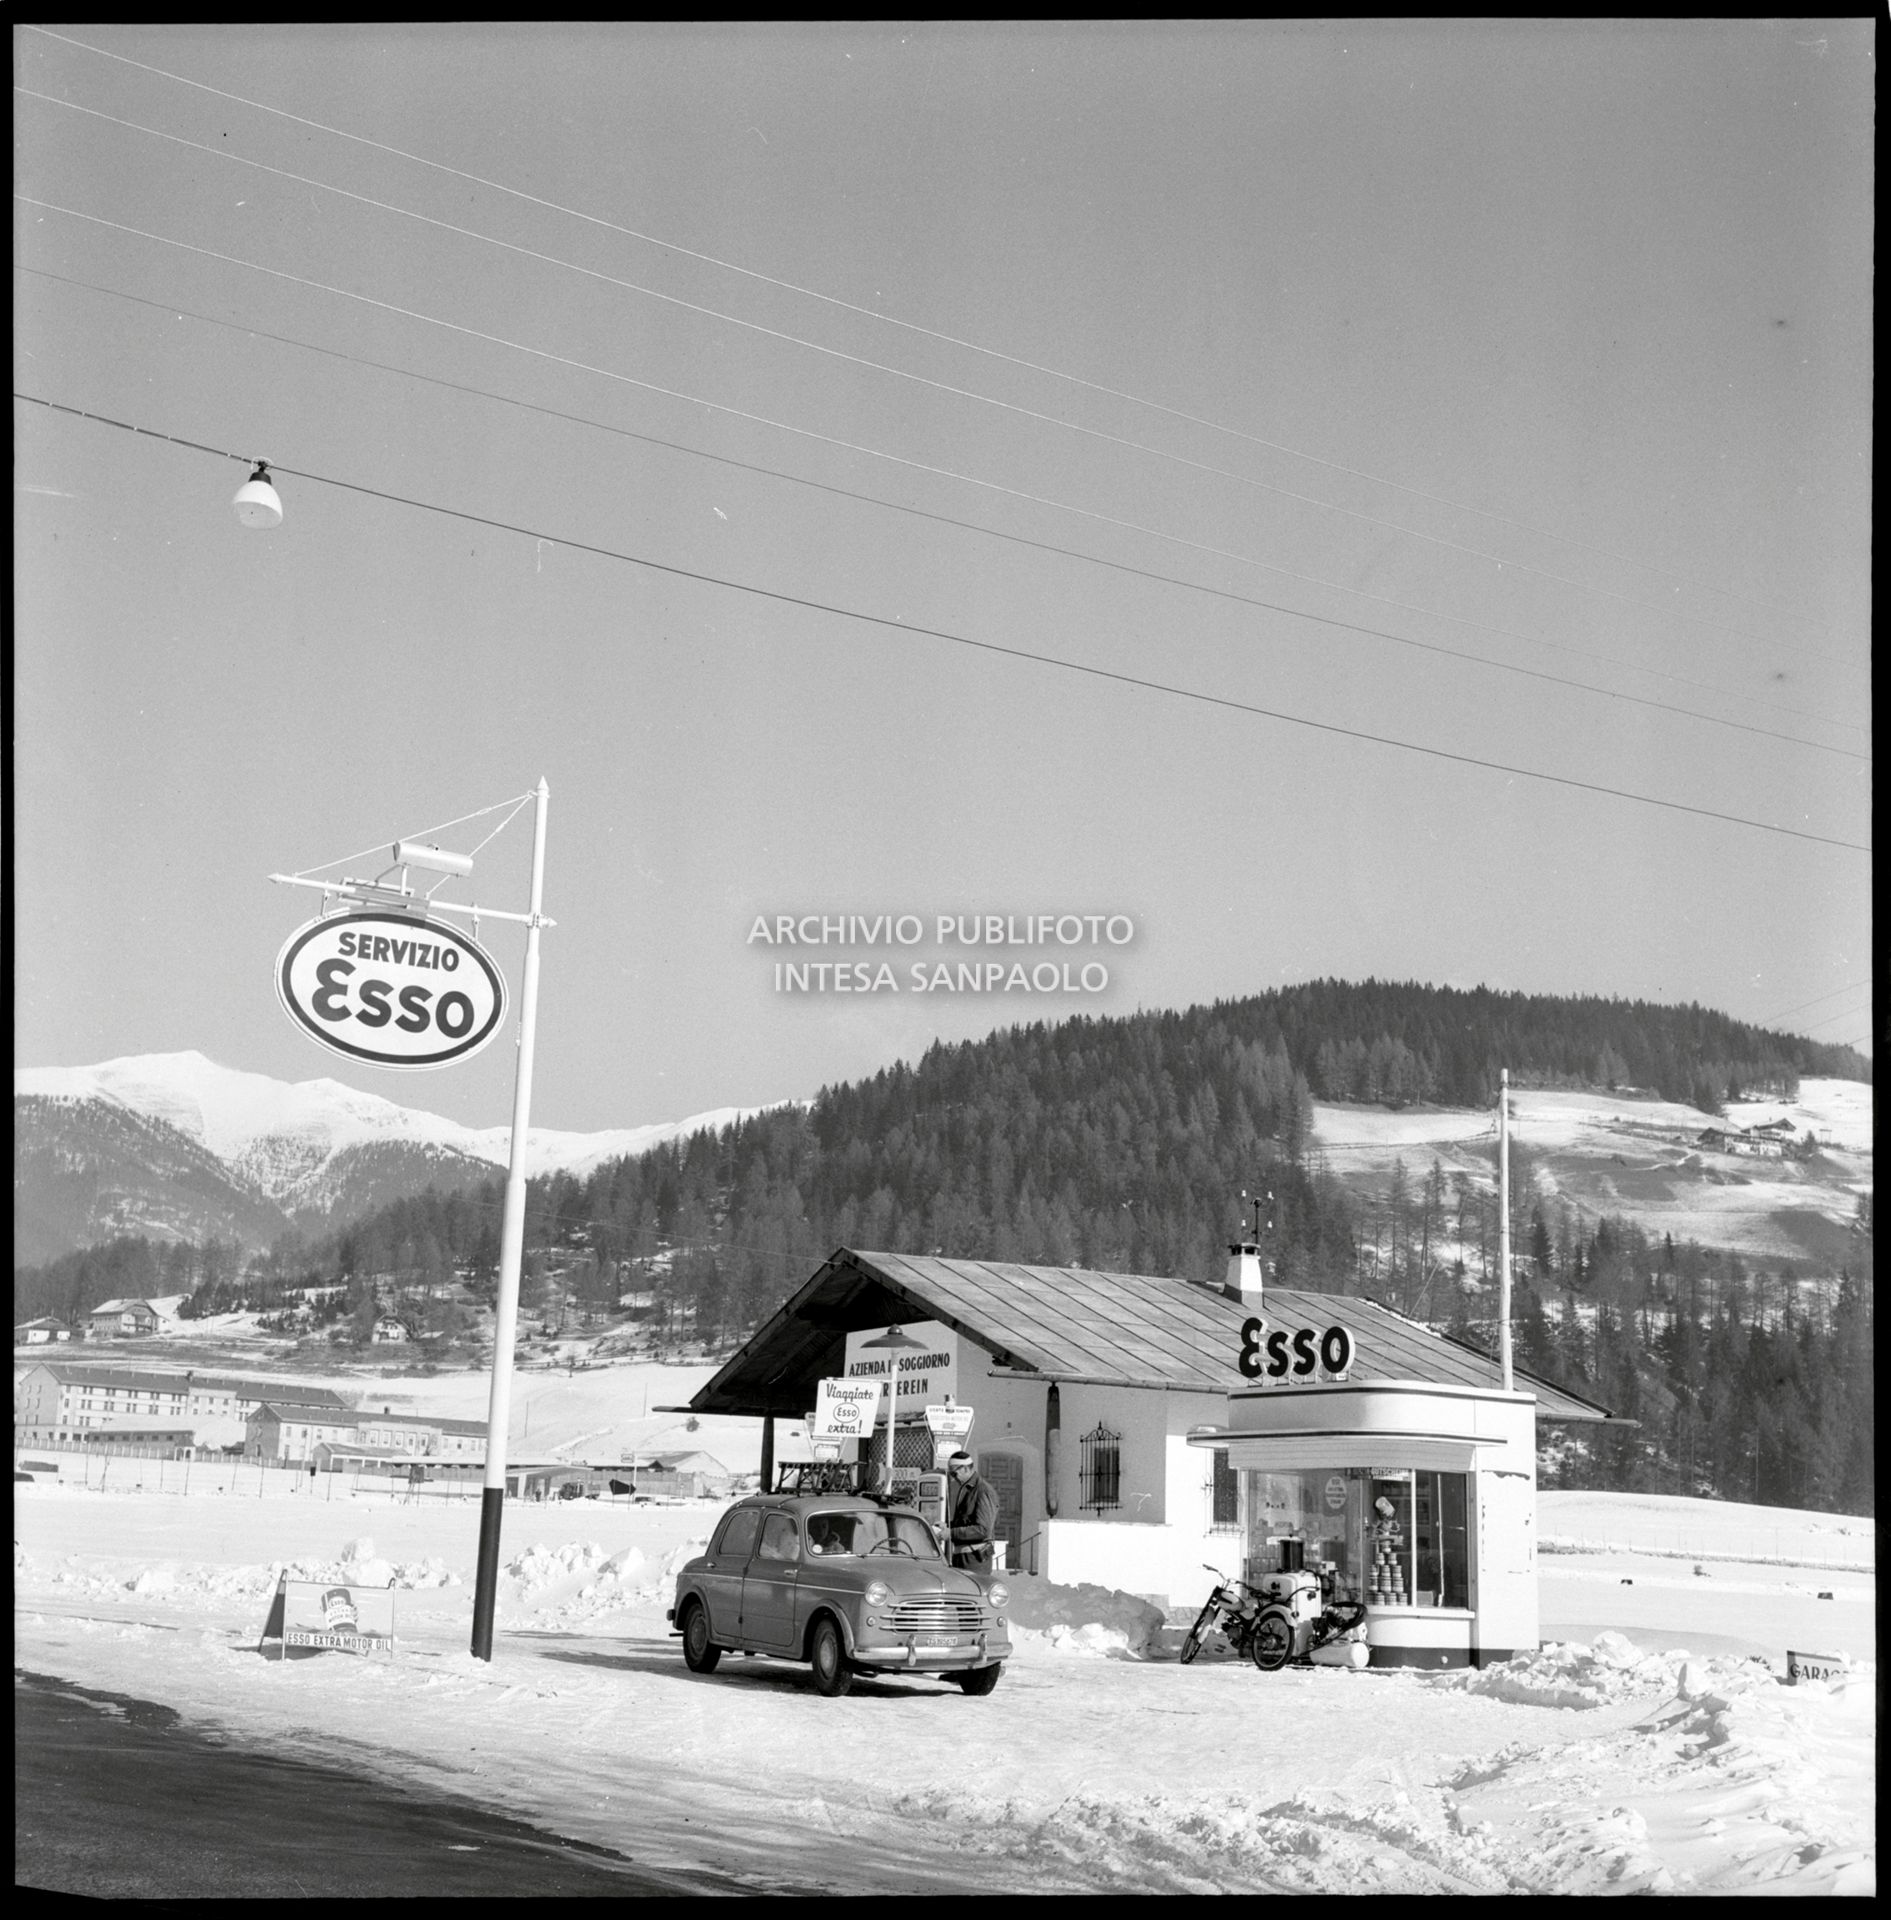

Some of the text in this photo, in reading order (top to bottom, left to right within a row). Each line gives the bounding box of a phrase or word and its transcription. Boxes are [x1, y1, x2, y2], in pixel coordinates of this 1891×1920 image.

[338, 931, 460, 972] SERVIZIO
[849, 1360, 886, 1377] AZIENDA
[898, 1352, 951, 1372] SOGGIORNO
[826, 1383, 874, 1402] Viaggiate
[827, 1419, 863, 1434] extra!
[288, 1633, 389, 1651] ESSO EXTRA MOTOR OIL
[1790, 1663, 1850, 1681] GARA
